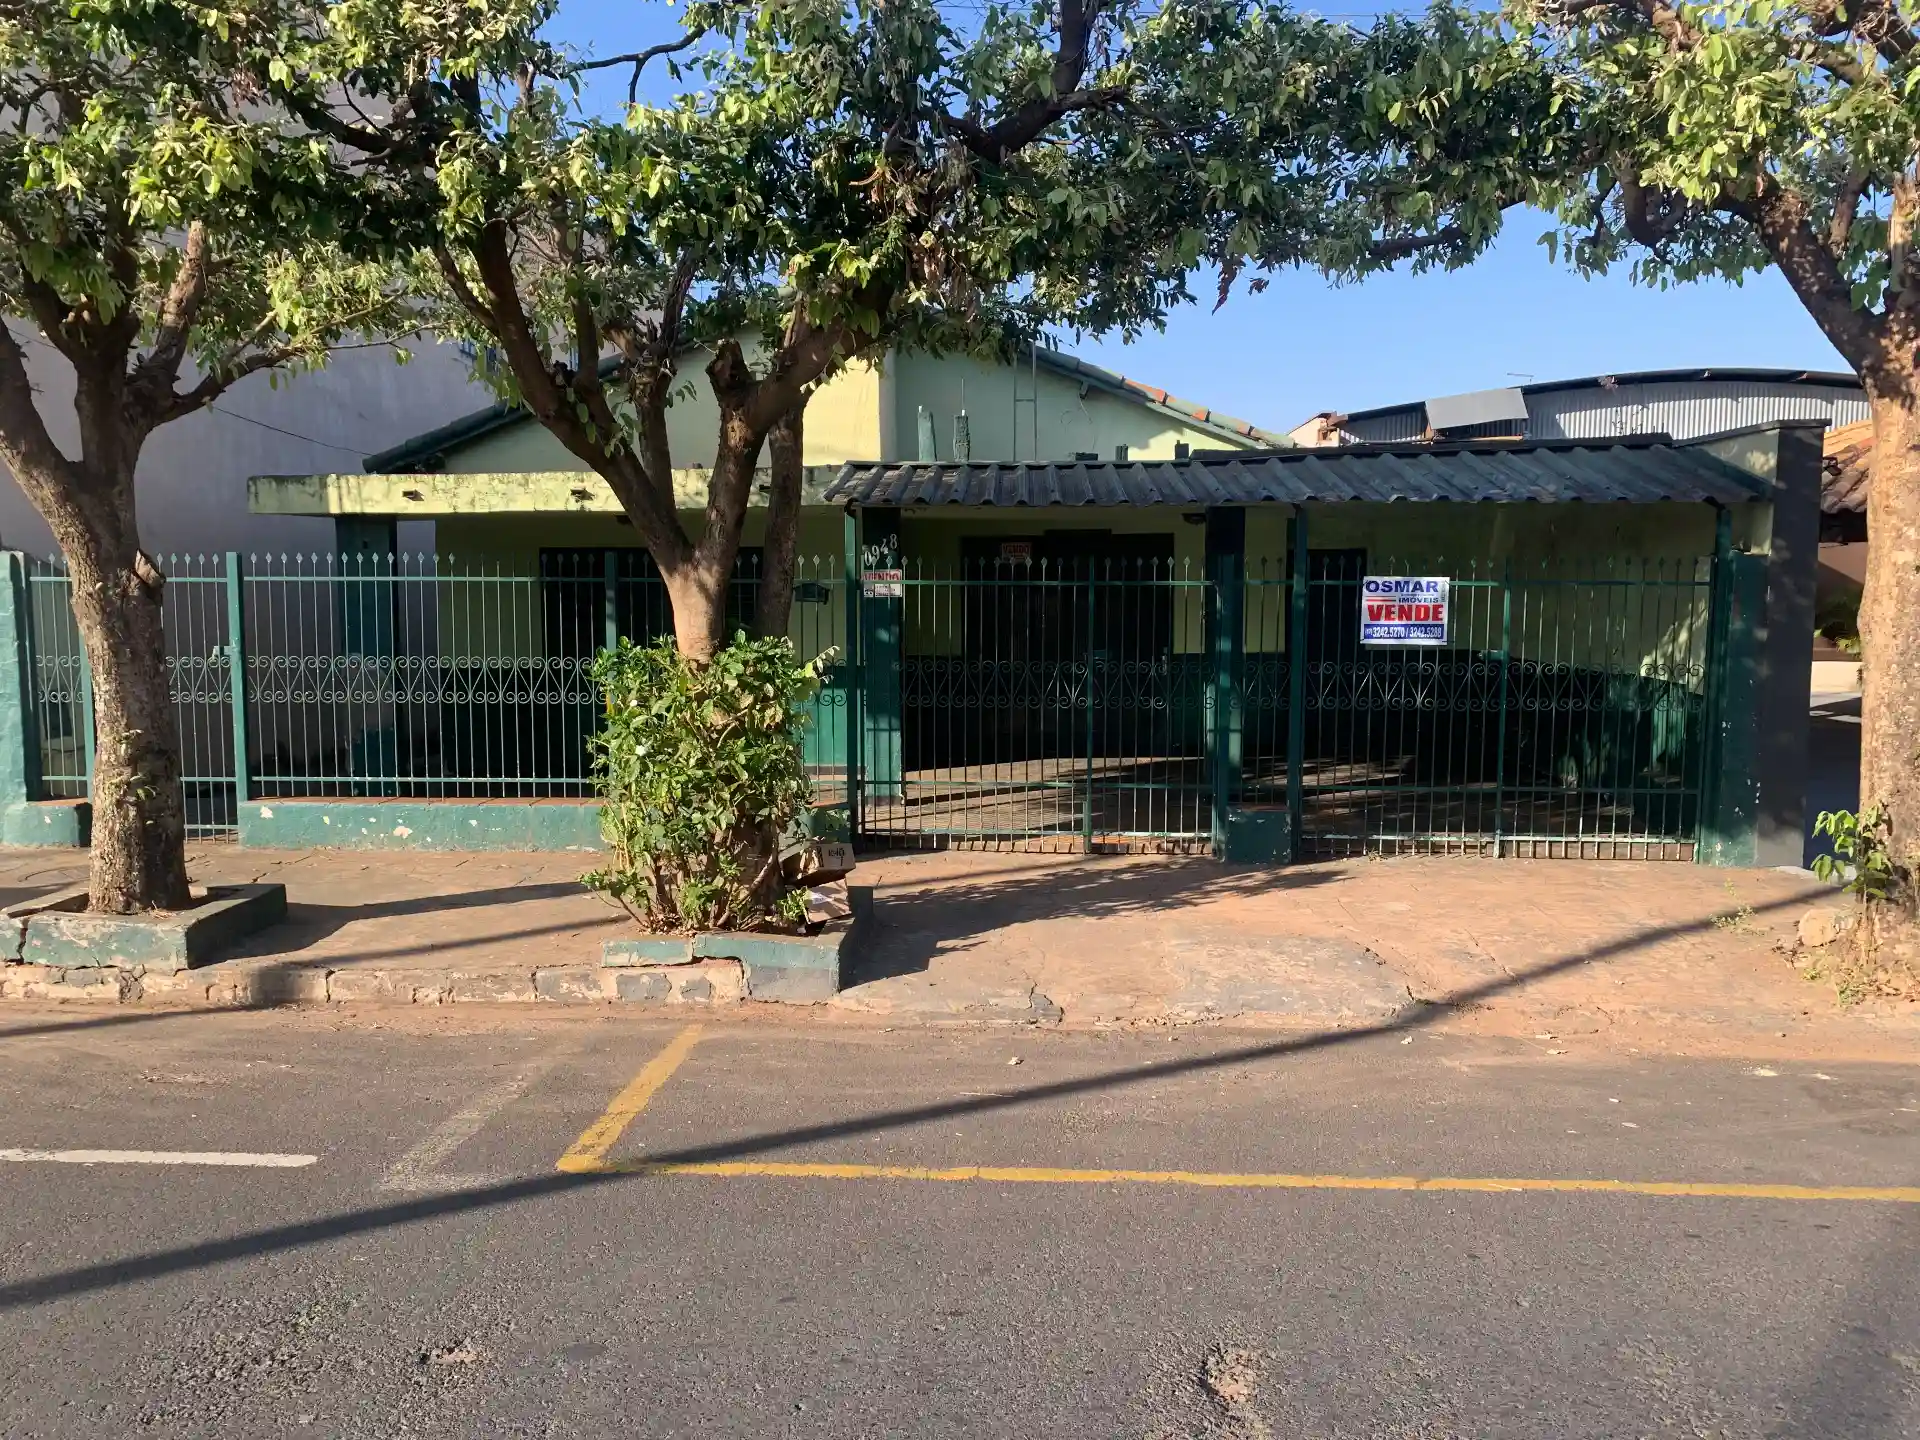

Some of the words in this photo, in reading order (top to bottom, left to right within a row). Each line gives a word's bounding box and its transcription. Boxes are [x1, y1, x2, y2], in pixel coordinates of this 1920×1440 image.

[864, 533, 898, 567] 0948
[1366, 580, 1439, 592] OSMAR
[1367, 604, 1444, 621] VENDE
